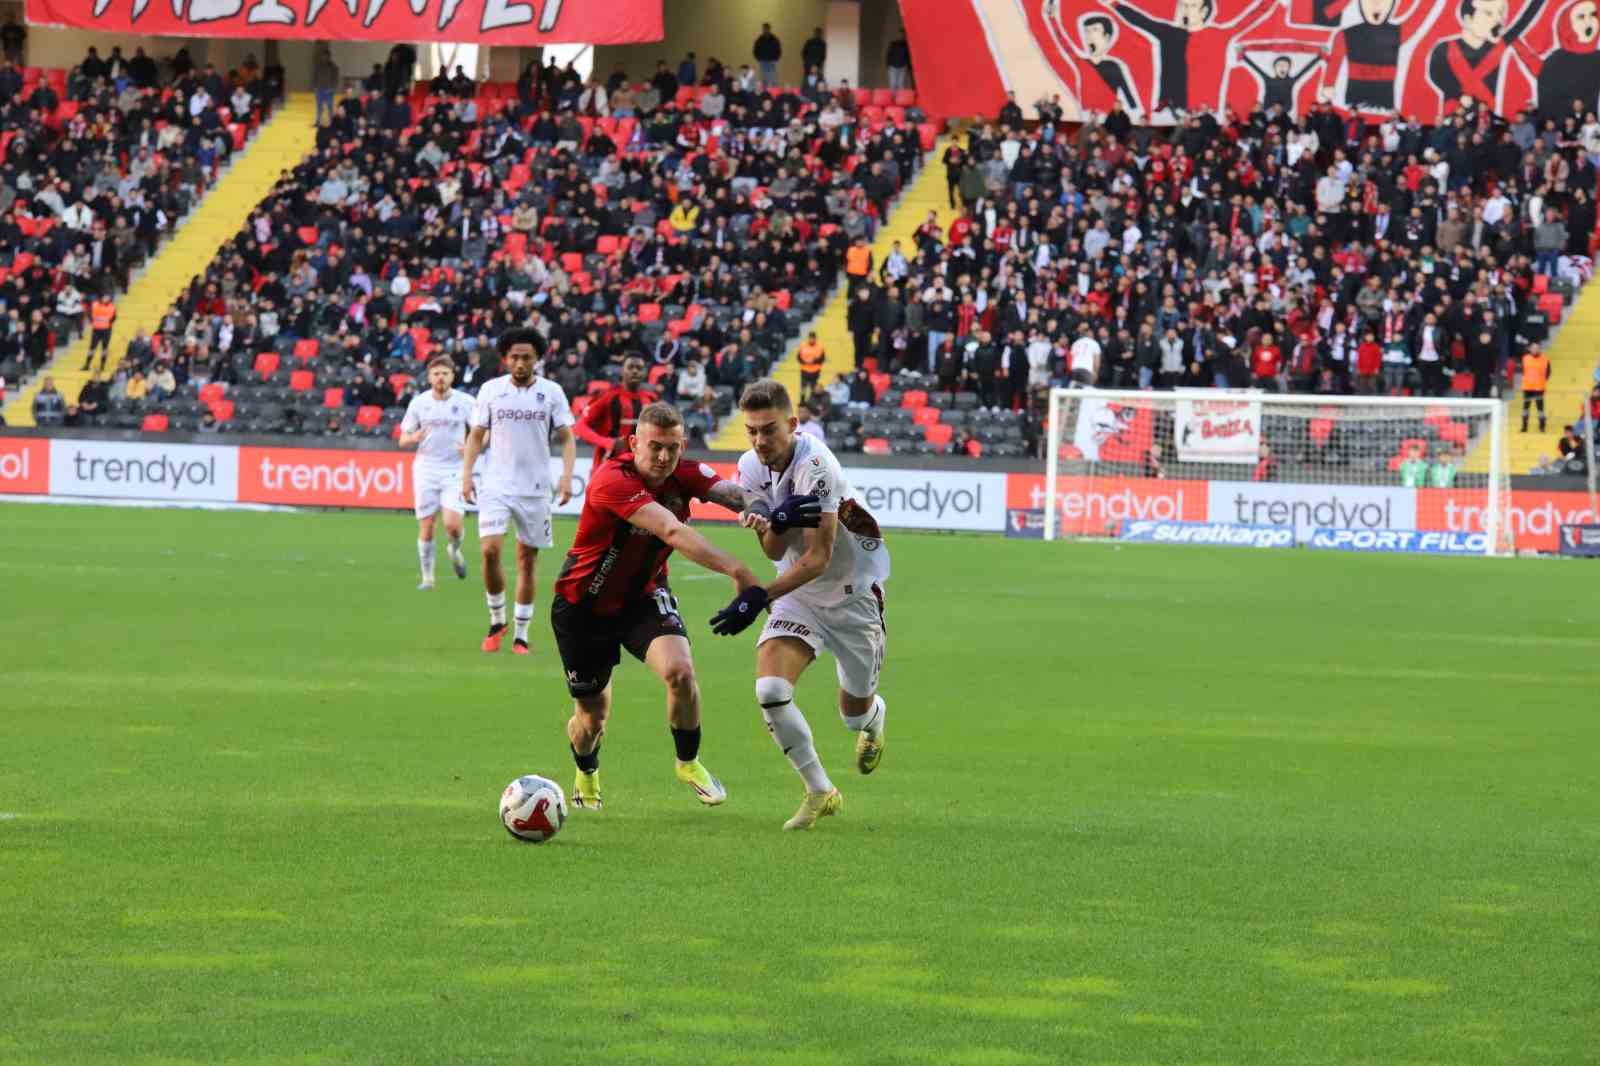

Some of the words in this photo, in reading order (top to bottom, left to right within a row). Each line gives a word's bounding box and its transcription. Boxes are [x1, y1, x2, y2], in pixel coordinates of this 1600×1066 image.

[74, 450, 216, 490] trendyol
[259, 456, 404, 497] trendyol
[854, 481, 982, 519] endyol
[1233, 493, 1391, 529] trendyol
